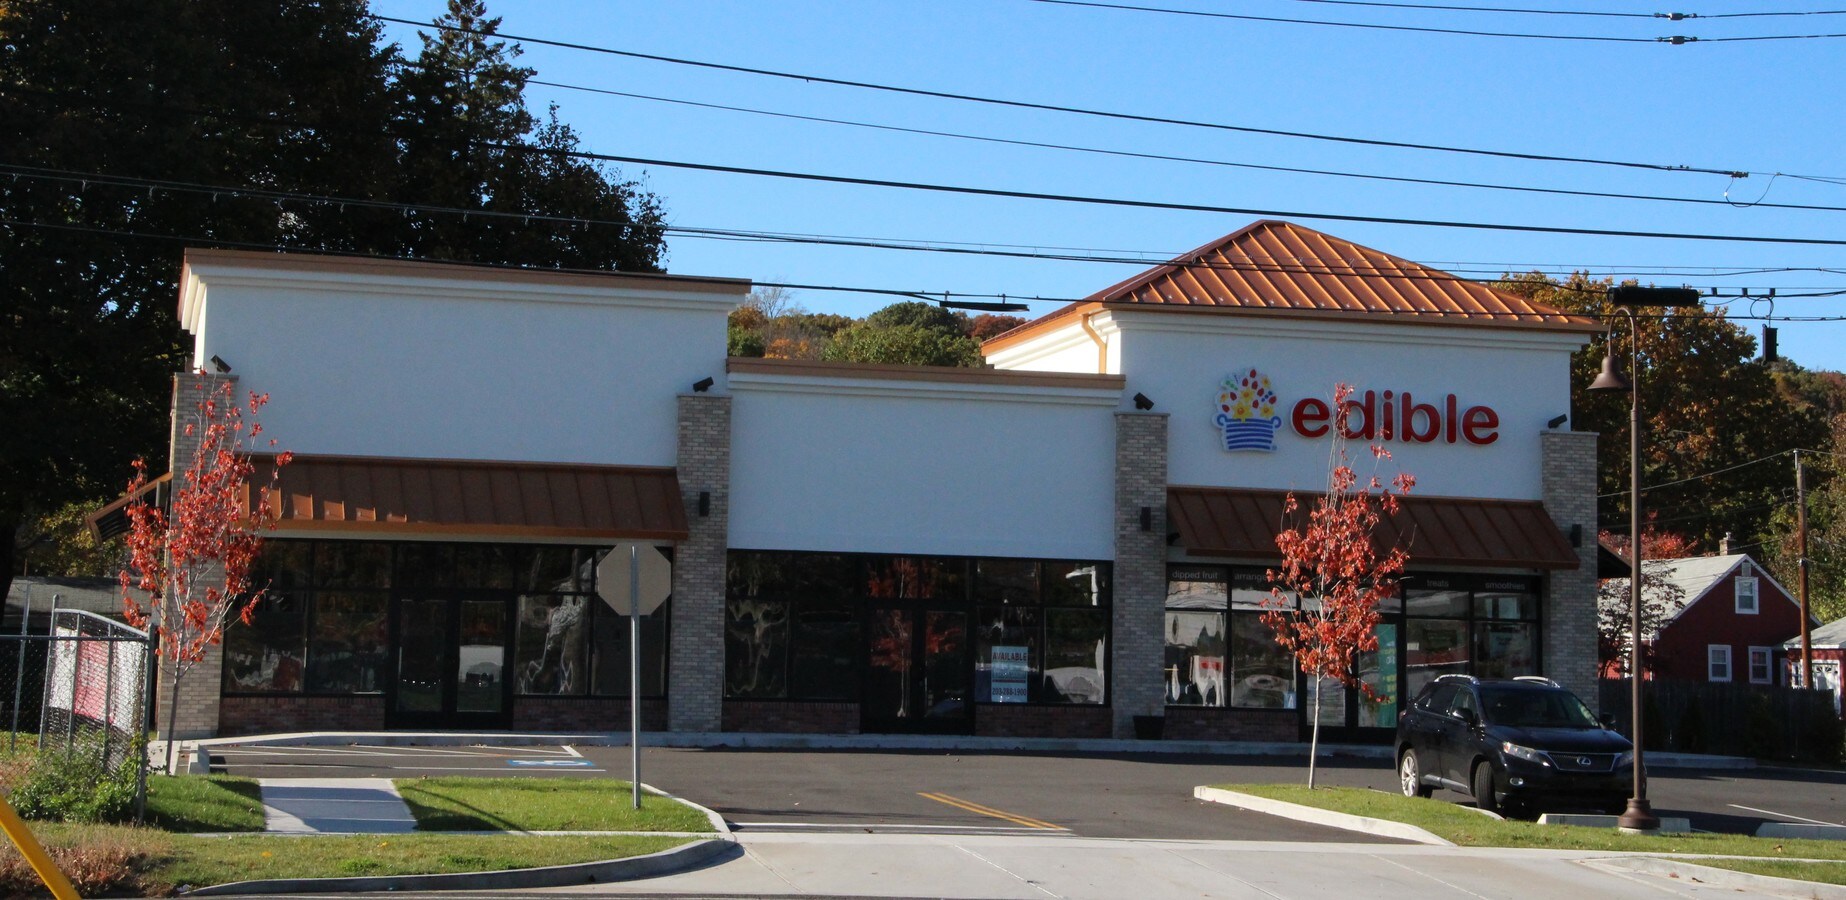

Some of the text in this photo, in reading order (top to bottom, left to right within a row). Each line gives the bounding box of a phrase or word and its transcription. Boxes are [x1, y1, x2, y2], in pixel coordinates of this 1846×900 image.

[1291, 389, 1500, 446] edible
[1172, 569, 1218, 580] dipped fruit
[1426, 579, 1449, 588] treats
[1485, 581, 1525, 590] smoothies
[992, 652, 1028, 661] AVAILABLE
